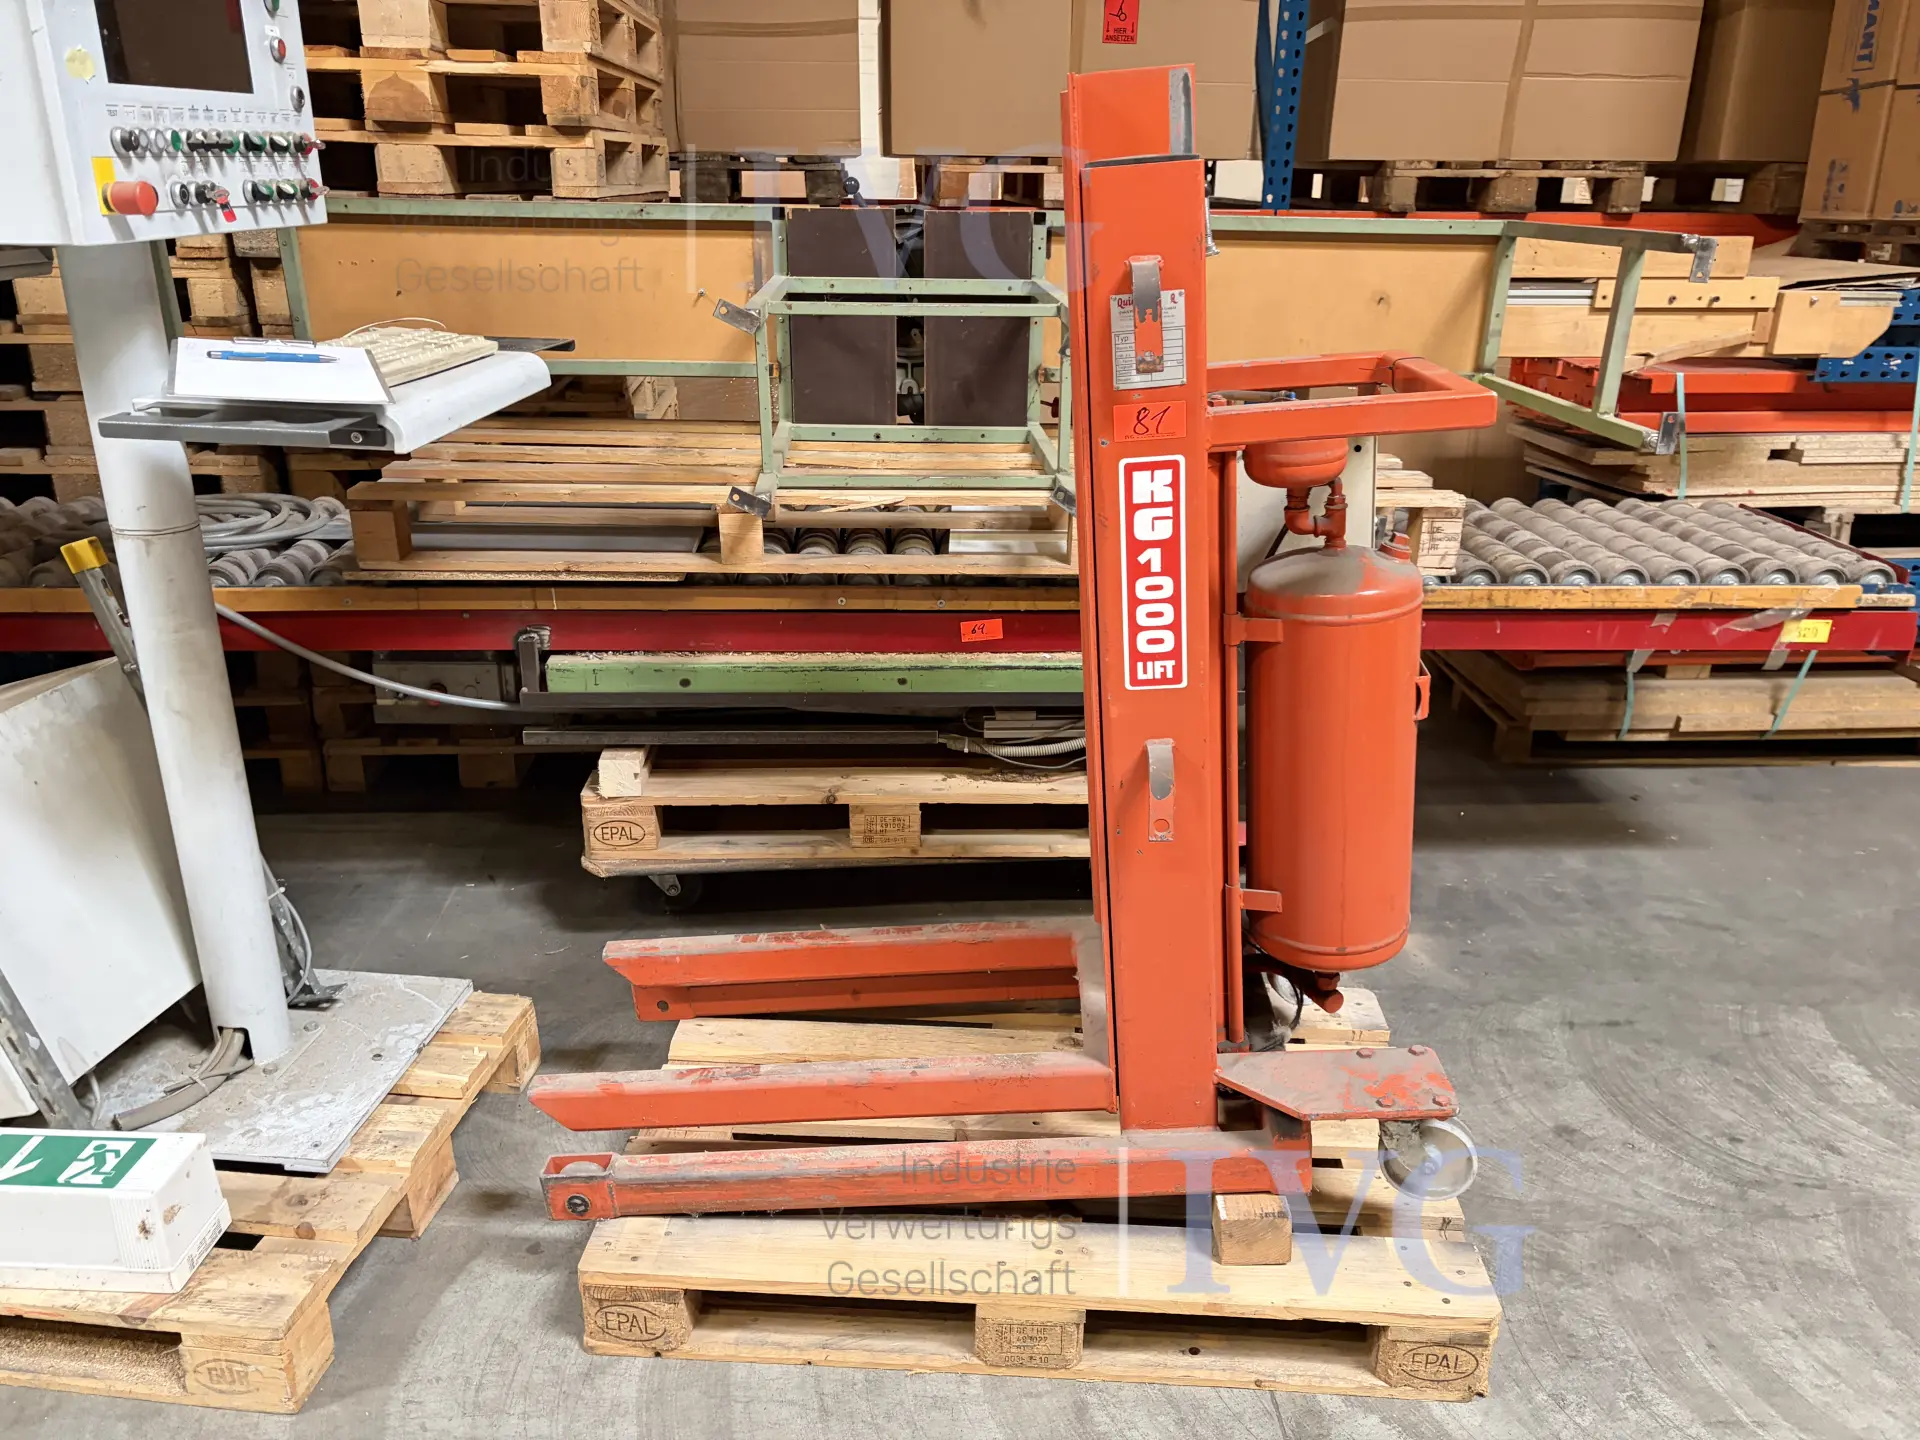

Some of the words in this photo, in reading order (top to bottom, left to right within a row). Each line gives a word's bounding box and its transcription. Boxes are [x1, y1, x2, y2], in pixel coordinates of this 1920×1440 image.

[1105, 34, 1134, 42] ANSETZEN
[106, 109, 118, 117] TEST
[1116, 335, 1129, 344] Typ
[1133, 406, 1171, 435] 81
[1136, 659, 1176, 681] LIFT
[600, 826, 639, 841] EPAL
[604, 1311, 657, 1336] EPAL
[1410, 1352, 1468, 1374] EPAL
